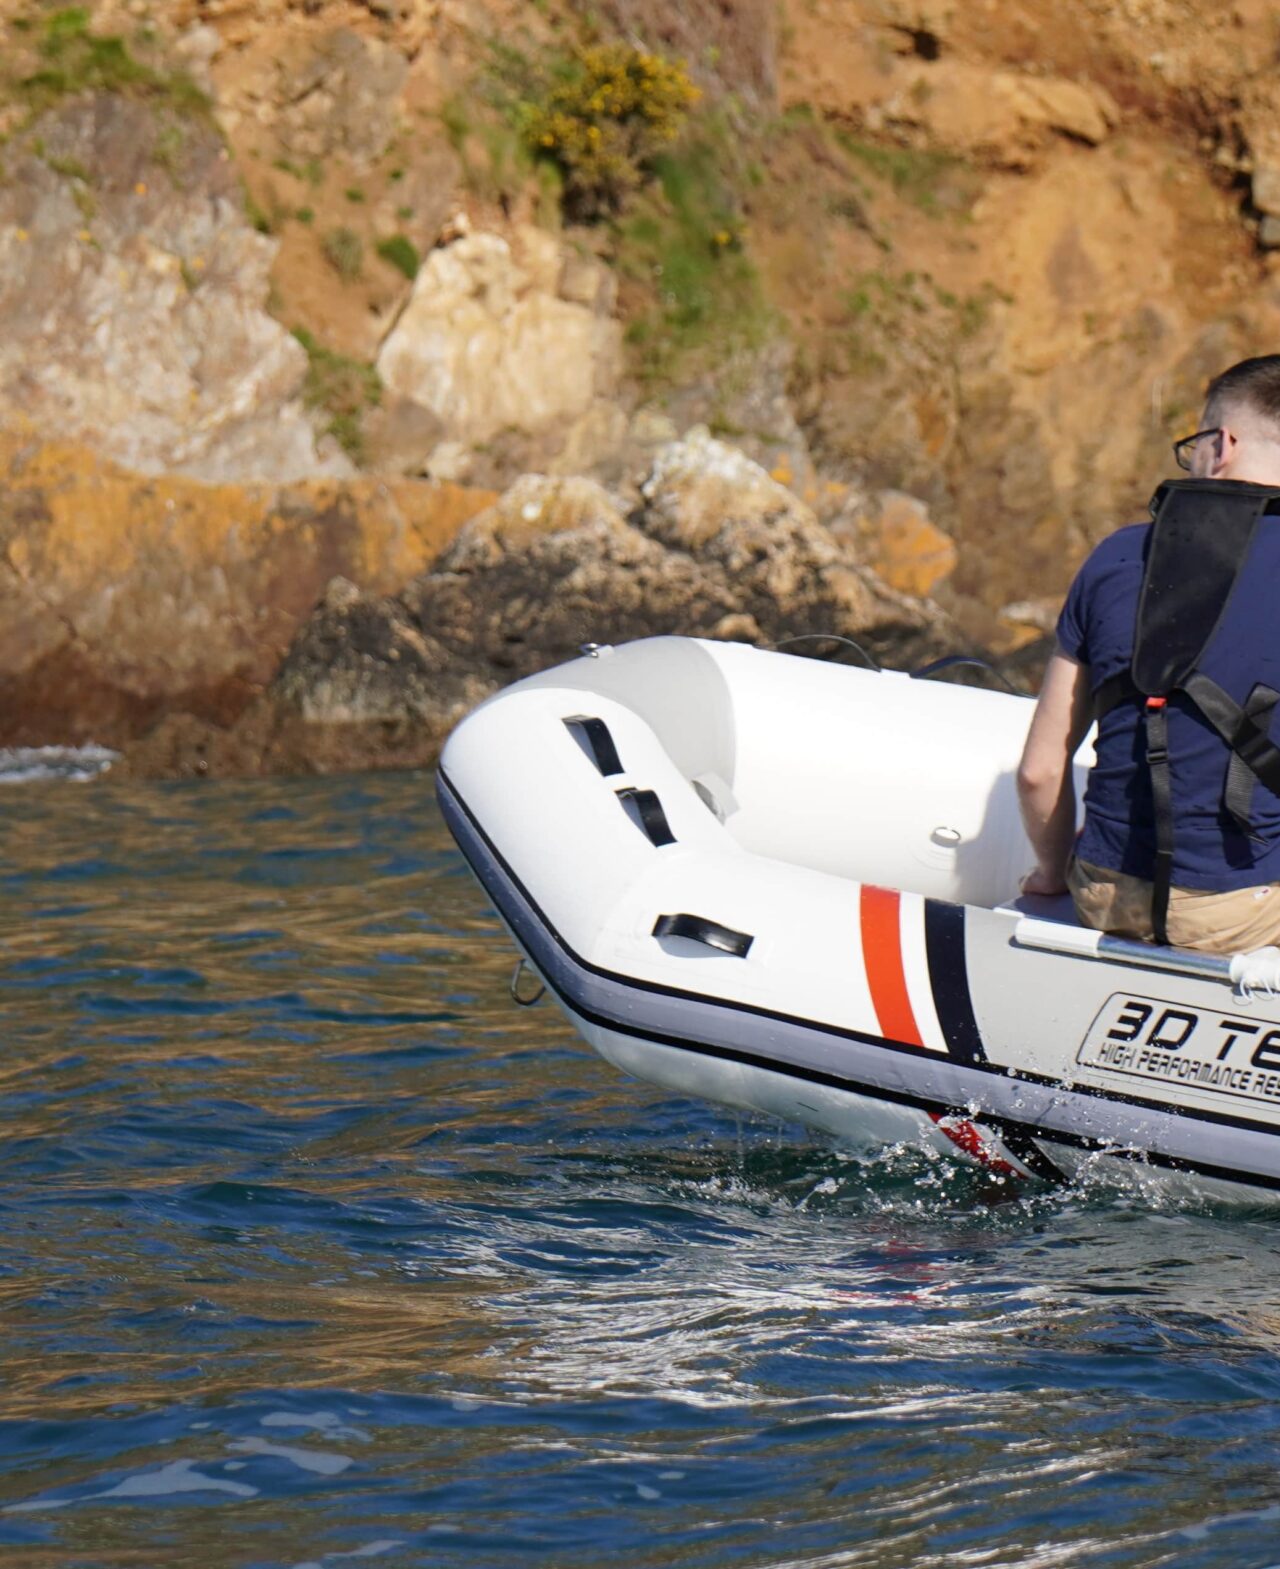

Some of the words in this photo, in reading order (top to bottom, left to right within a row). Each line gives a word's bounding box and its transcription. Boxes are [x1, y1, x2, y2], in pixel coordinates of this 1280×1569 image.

[1107, 1002, 1198, 1050] 3D
[1099, 1043, 1136, 1068] HIGH
[1136, 1050, 1253, 1090] PERFORMANCE
